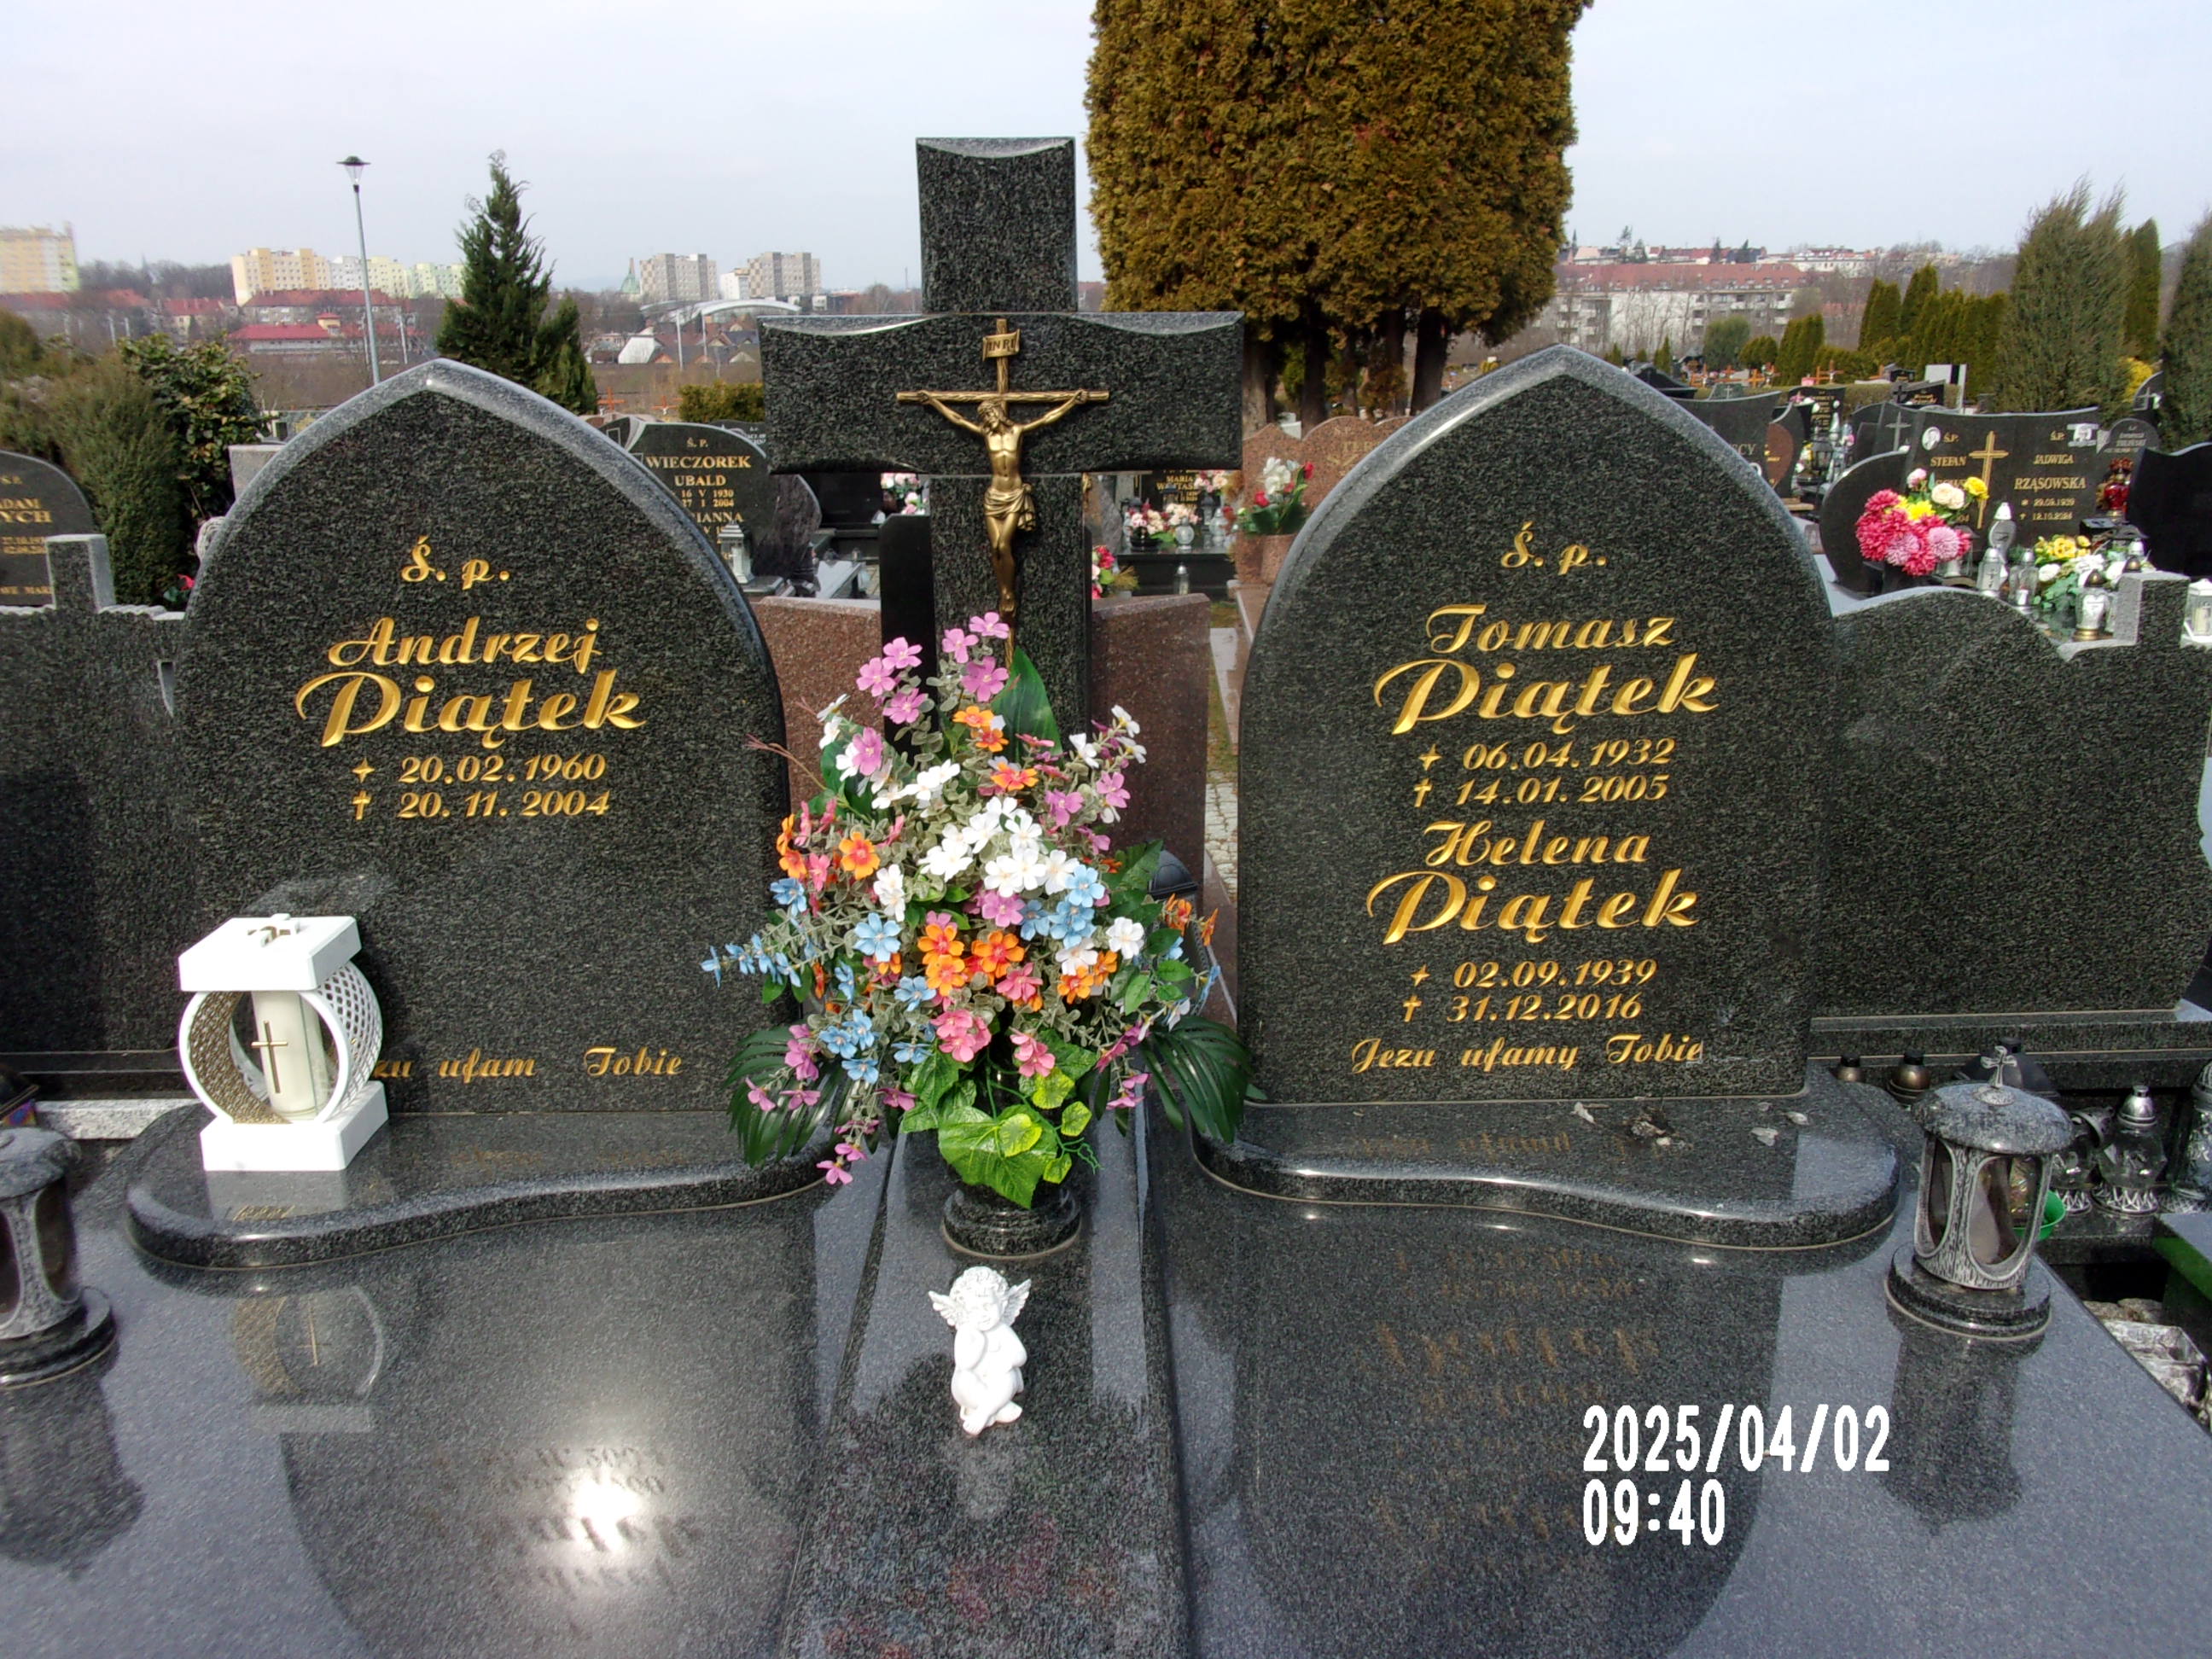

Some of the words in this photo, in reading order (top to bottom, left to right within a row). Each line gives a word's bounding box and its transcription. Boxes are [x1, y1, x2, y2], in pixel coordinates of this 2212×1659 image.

[989, 339, 1015, 351] INRI
[646, 456, 751, 469] WIECZOREK
[1930, 456, 1967, 467] STEFAN
[2033, 454, 2075, 465] JADWIGA
[674, 474, 725, 486] UBALD
[713, 489, 734, 498] 1930
[2014, 477, 2087, 493] RZĄSOWSKA
[401, 535, 446, 583] Ś.
[461, 558, 510, 590] p.
[1500, 521, 1544, 568] Ś.
[1558, 544, 1608, 575] p.
[327, 615, 602, 675] Andrzej
[1426, 603, 1675, 654] Tomasz
[294, 668, 646, 749] Piątek
[1373, 652, 1720, 735] Piątek
[399, 752, 607, 785] 20.02.1960
[1463, 737, 1676, 771] 06.04.1932
[1423, 819, 1650, 867] Helena
[1365, 867, 1699, 945] Piątek
[1453, 958, 1657, 989] 02.09.1939
[1447, 992, 1643, 1022] 31.12.2016
[438, 1047, 537, 1084] ufam
[585, 1045, 683, 1076] Tobie
[1351, 1037, 1436, 1074] Jezu
[1460, 1037, 1579, 1072] ufamy
[1605, 1033, 1703, 1064] Tobie
